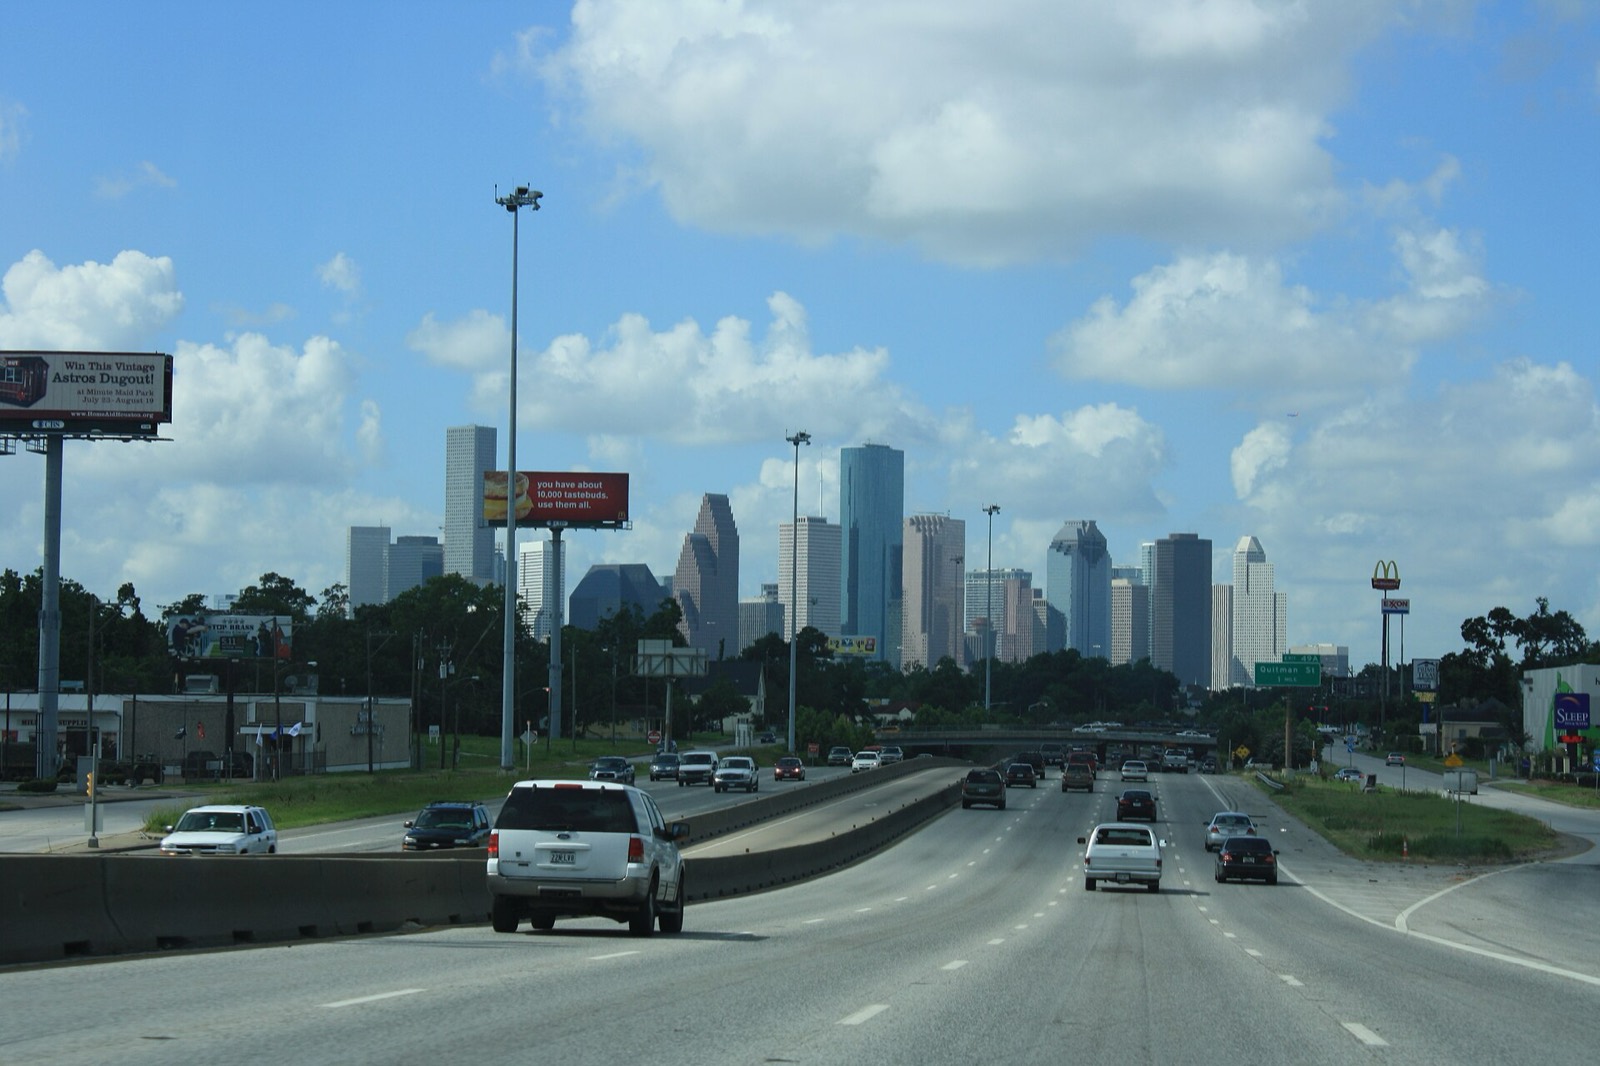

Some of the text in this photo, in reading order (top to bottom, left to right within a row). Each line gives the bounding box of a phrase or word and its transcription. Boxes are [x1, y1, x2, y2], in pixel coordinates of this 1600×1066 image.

[65, 361, 155, 373] Win This Vintage
[52, 372, 154, 387] Astros Dugout!
[87, 388, 113, 396] Minute
[135, 389, 154, 397] Park
[82, 396, 99, 405] July
[555, 480, 576, 489] have
[577, 481, 603, 489] about
[537, 491, 609, 499] 10,000 tastebuds.
[555, 501, 577, 509] them
[578, 501, 592, 509] all.
[1305, 666, 1315, 674] St
[1557, 708, 1588, 723] SLEEP
